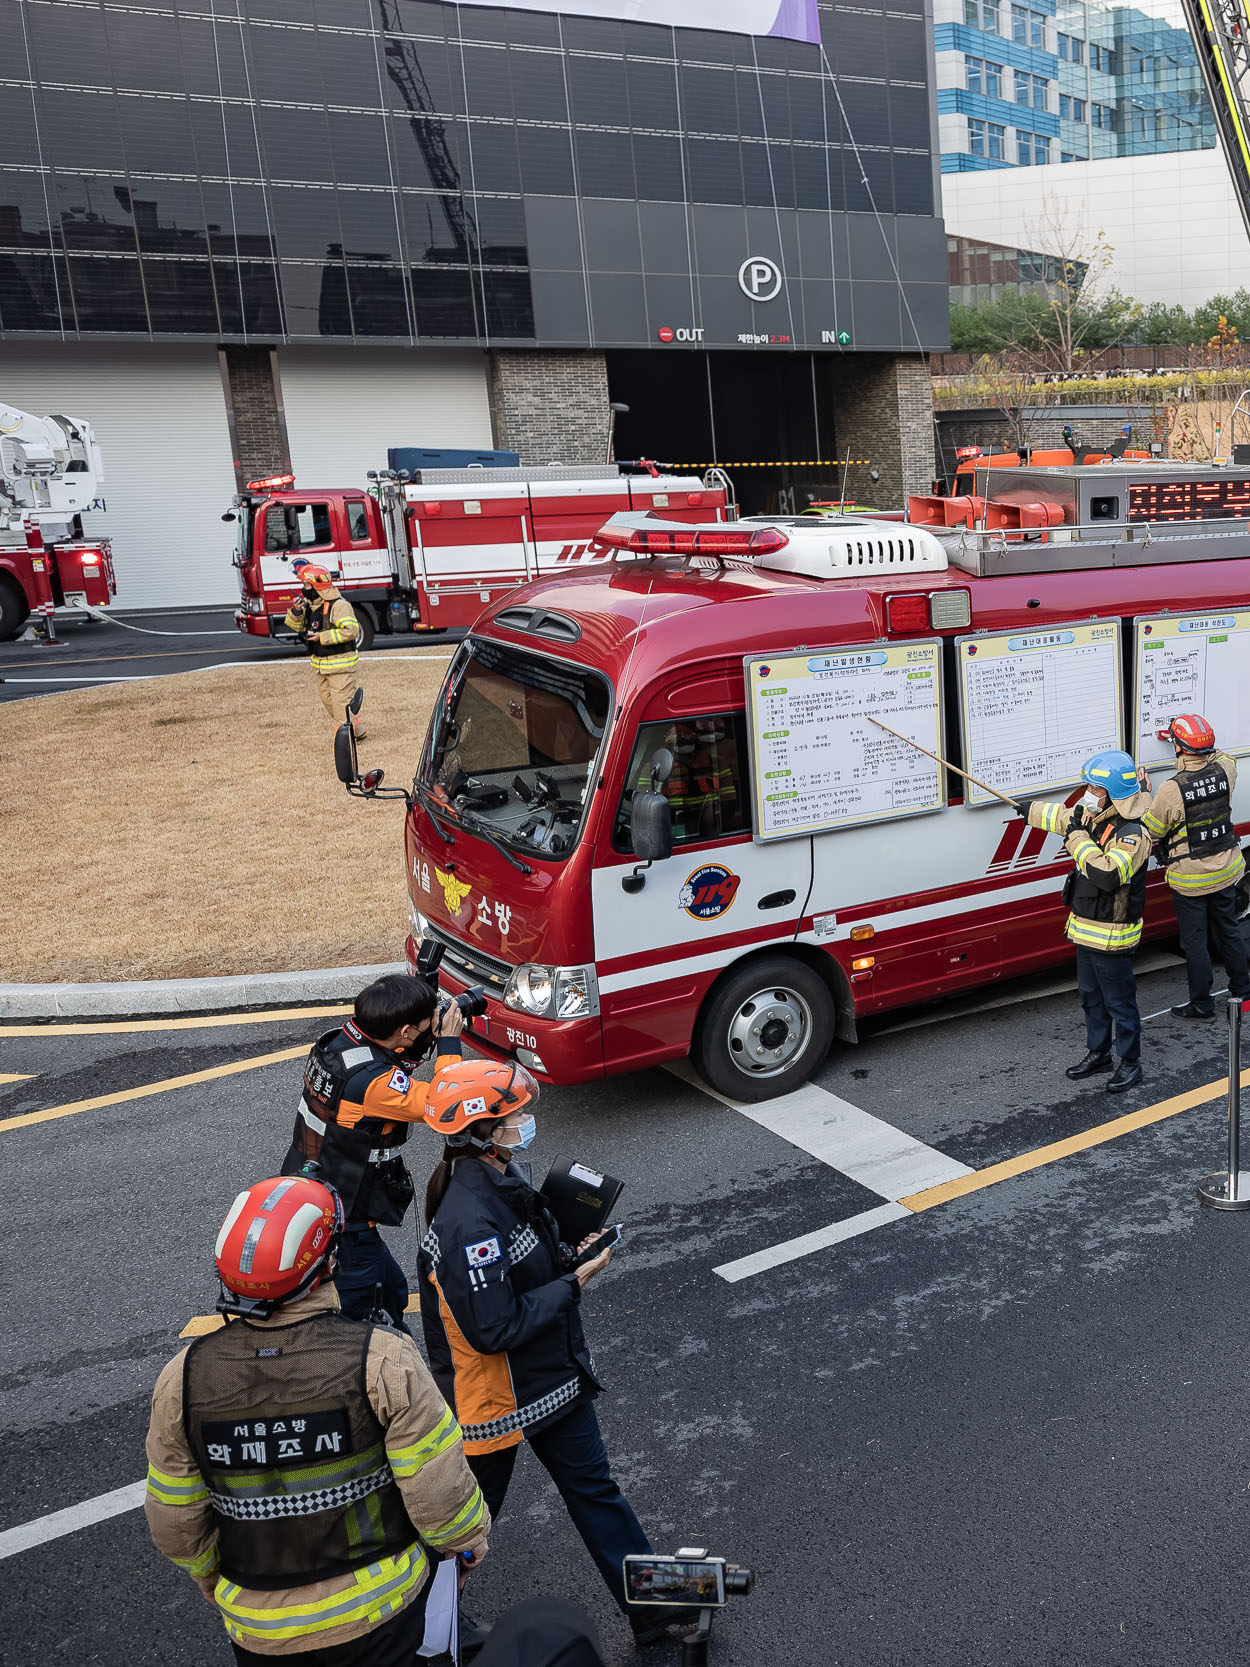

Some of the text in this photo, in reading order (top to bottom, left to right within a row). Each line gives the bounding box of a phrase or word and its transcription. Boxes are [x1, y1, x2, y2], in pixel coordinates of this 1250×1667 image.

[751, 264, 772, 293] P
[676, 328, 704, 341] OUT
[737, 333, 790, 344] 제한높이 2.3M
[821, 330, 835, 343] IN
[824, 655, 871, 668] 재난발생현황
[907, 649, 933, 659] 광진소방서
[1185, 780, 1227, 800] 화재조사
[412, 856, 511, 935] 서울 소방
[692, 875, 741, 905] 119
[700, 906, 720, 915] 서울소방
[312, 1227, 323, 1249] 119
[233, 1419, 307, 1437] 서울소방
[207, 1431, 342, 1465] 화재조사
